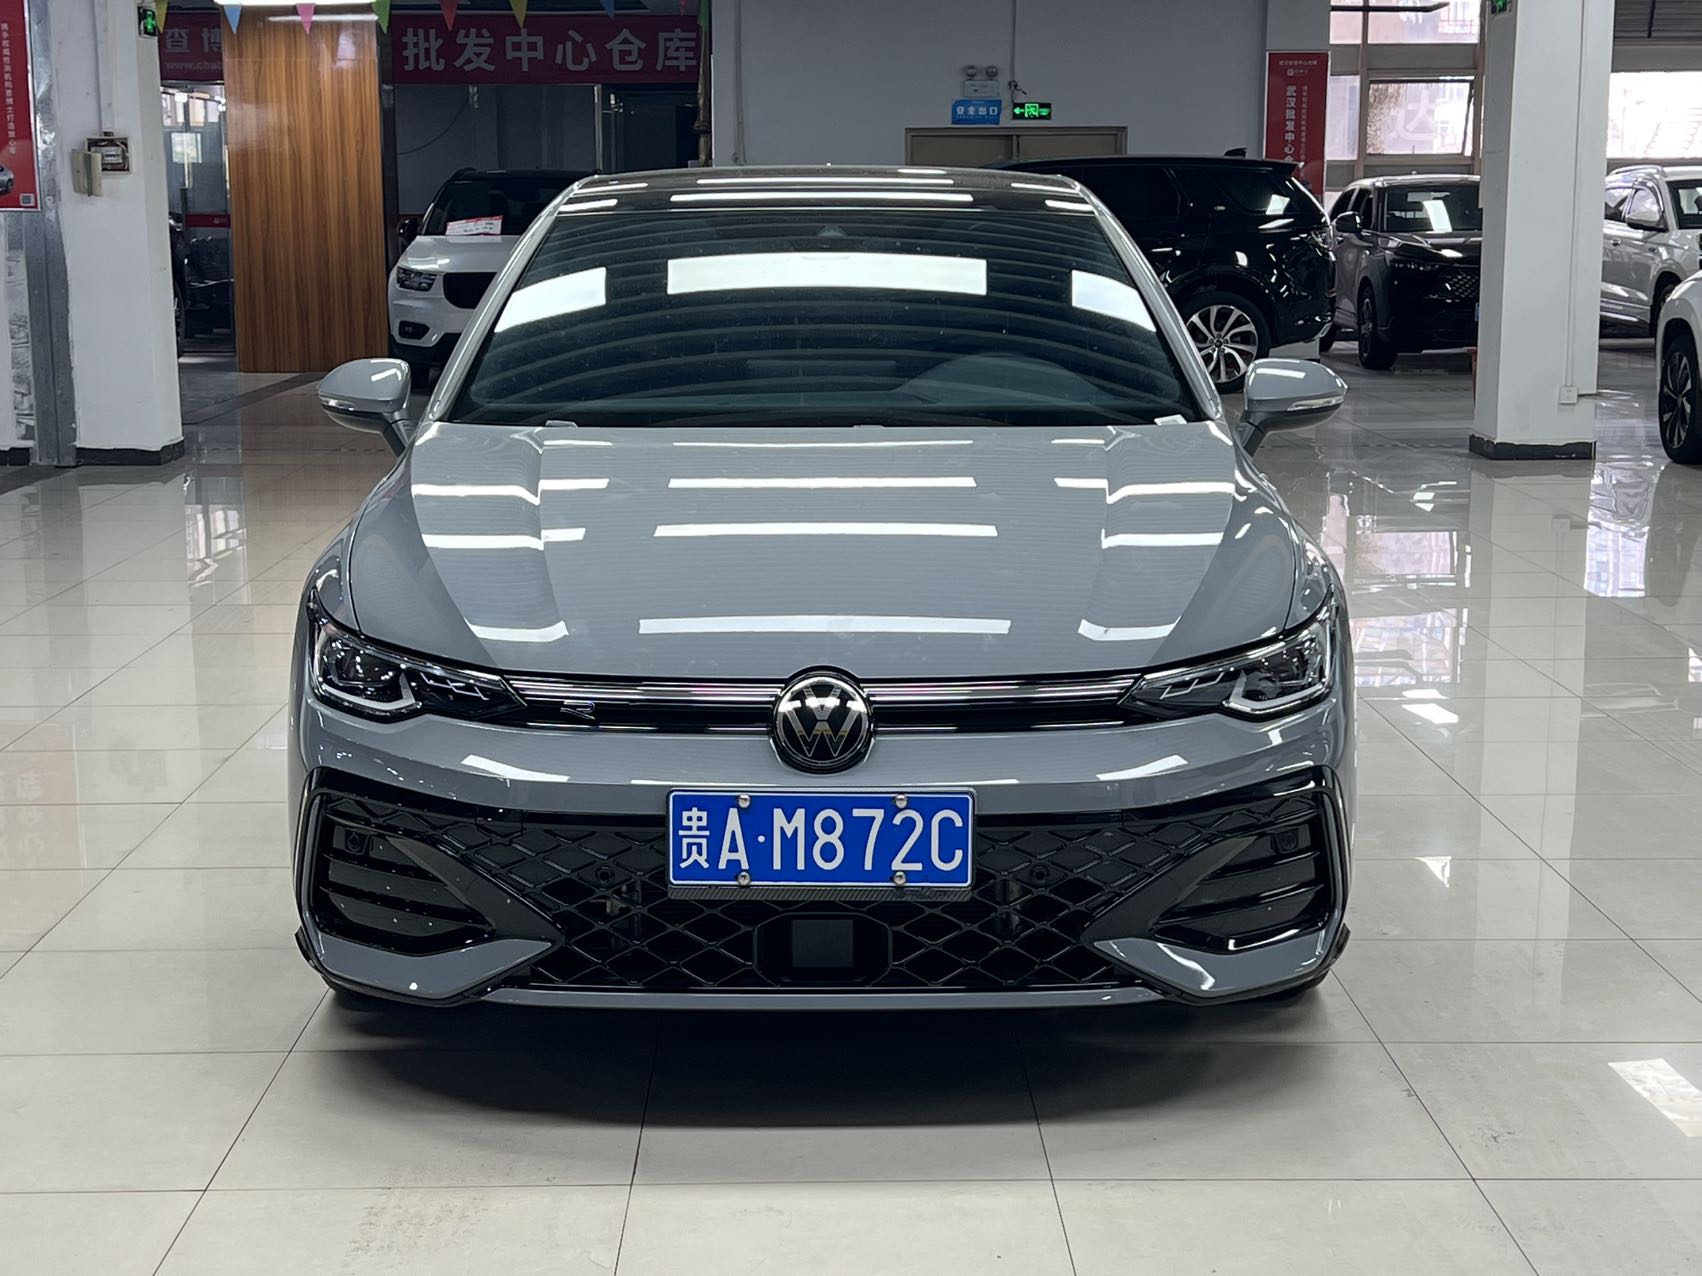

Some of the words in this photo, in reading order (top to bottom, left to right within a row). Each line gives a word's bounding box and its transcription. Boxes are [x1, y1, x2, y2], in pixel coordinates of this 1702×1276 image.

[401, 28, 698, 72] 批发中心仓库
[678, 807, 964, 871] 贵A·M872C
